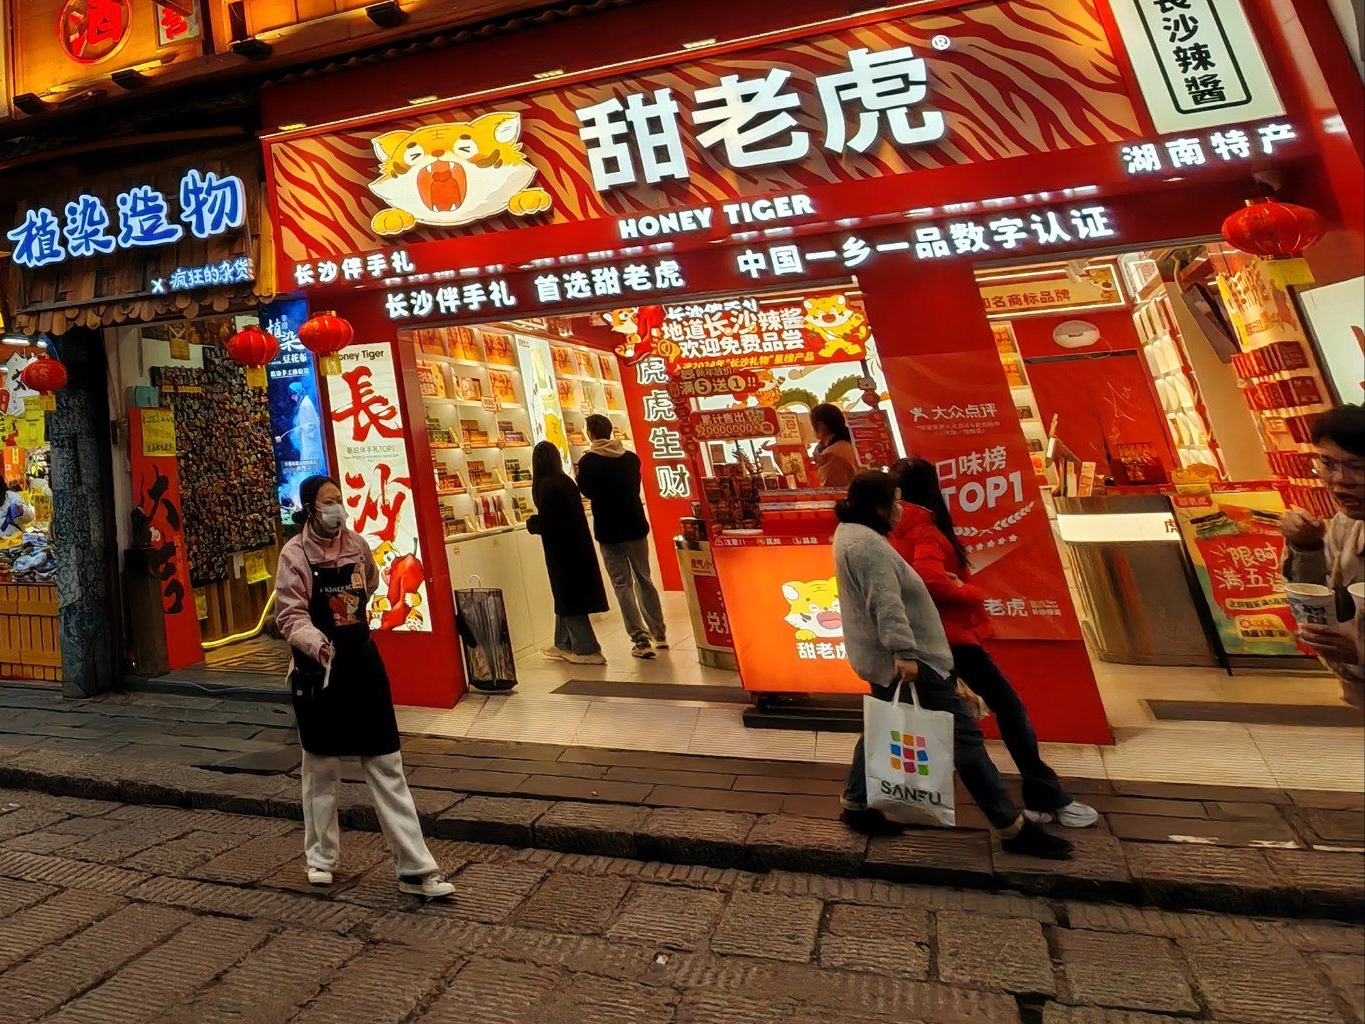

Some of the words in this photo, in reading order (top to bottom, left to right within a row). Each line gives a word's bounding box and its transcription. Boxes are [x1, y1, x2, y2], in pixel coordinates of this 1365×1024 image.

[576, 45, 946, 192] 甜老虎
[1121, 123, 1296, 175] 湖南特产
[8, 169, 245, 268] 植染造物
[619, 207, 712, 240] HONEY
[723, 193, 815, 224] TIGER
[170, 257, 254, 290] 疯狂的杂货
[294, 250, 415, 286] 长沙伴手礼
[385, 280, 517, 321] 长沙伴手礼
[534, 260, 686, 304] 首选甜老虎
[737, 205, 1115, 279] 中国一乡一品数字认证
[661, 307, 805, 342] 地道长沙辣酱
[361, 349, 384, 361] Tiger
[679, 329, 805, 359] 欢迎免费品尝
[636, 357, 692, 498] 虎虎生财
[931, 403, 998, 420] 大众点评
[936, 445, 1007, 480] 口味榜
[940, 470, 1024, 513] TOP1
[880, 779, 942, 805] SANFU
